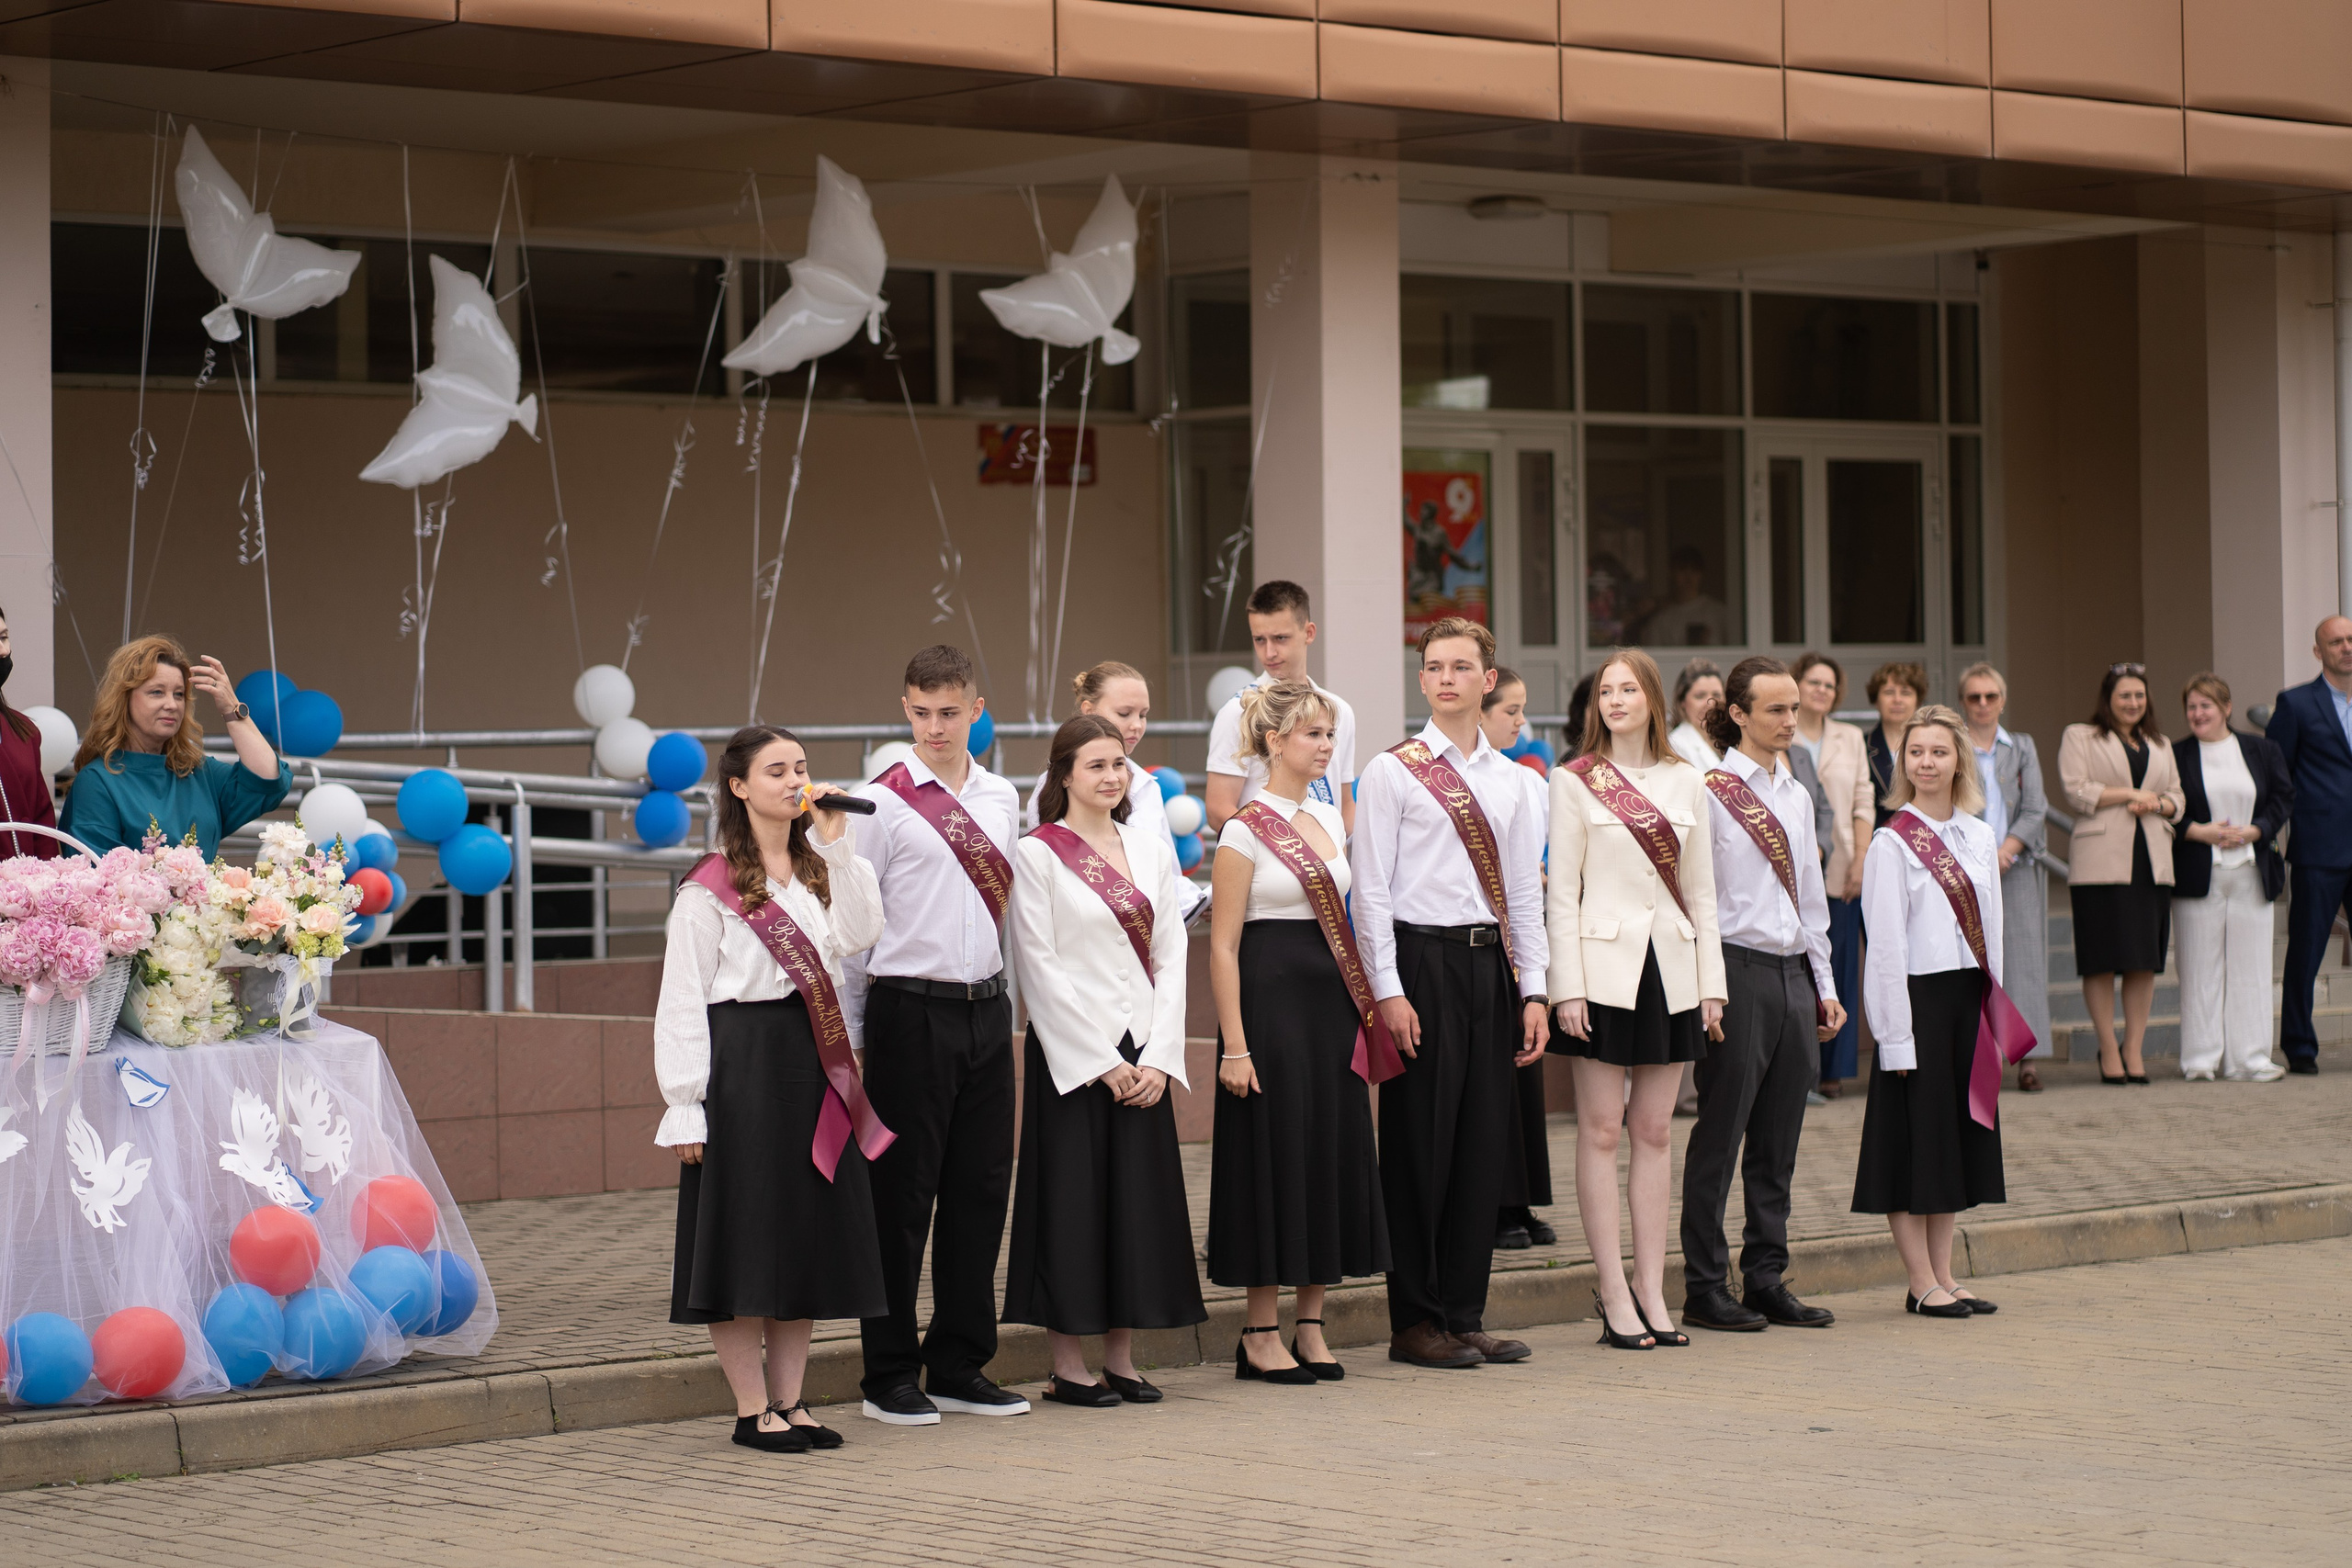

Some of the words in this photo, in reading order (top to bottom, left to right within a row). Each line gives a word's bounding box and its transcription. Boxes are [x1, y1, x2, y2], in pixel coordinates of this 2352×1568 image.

[1445, 479, 1475, 523] 9
[1259, 815, 1349, 961] Выпускница
[1429, 764, 1506, 911] Выпускник
[1932, 849, 1974, 931] Выпускница
[1314, 859, 1329, 885] Шпак
[1326, 881, 1344, 924] Елизавета
[767, 916, 825, 1016] Выпускница
[819, 1004, 847, 1046] 2026
